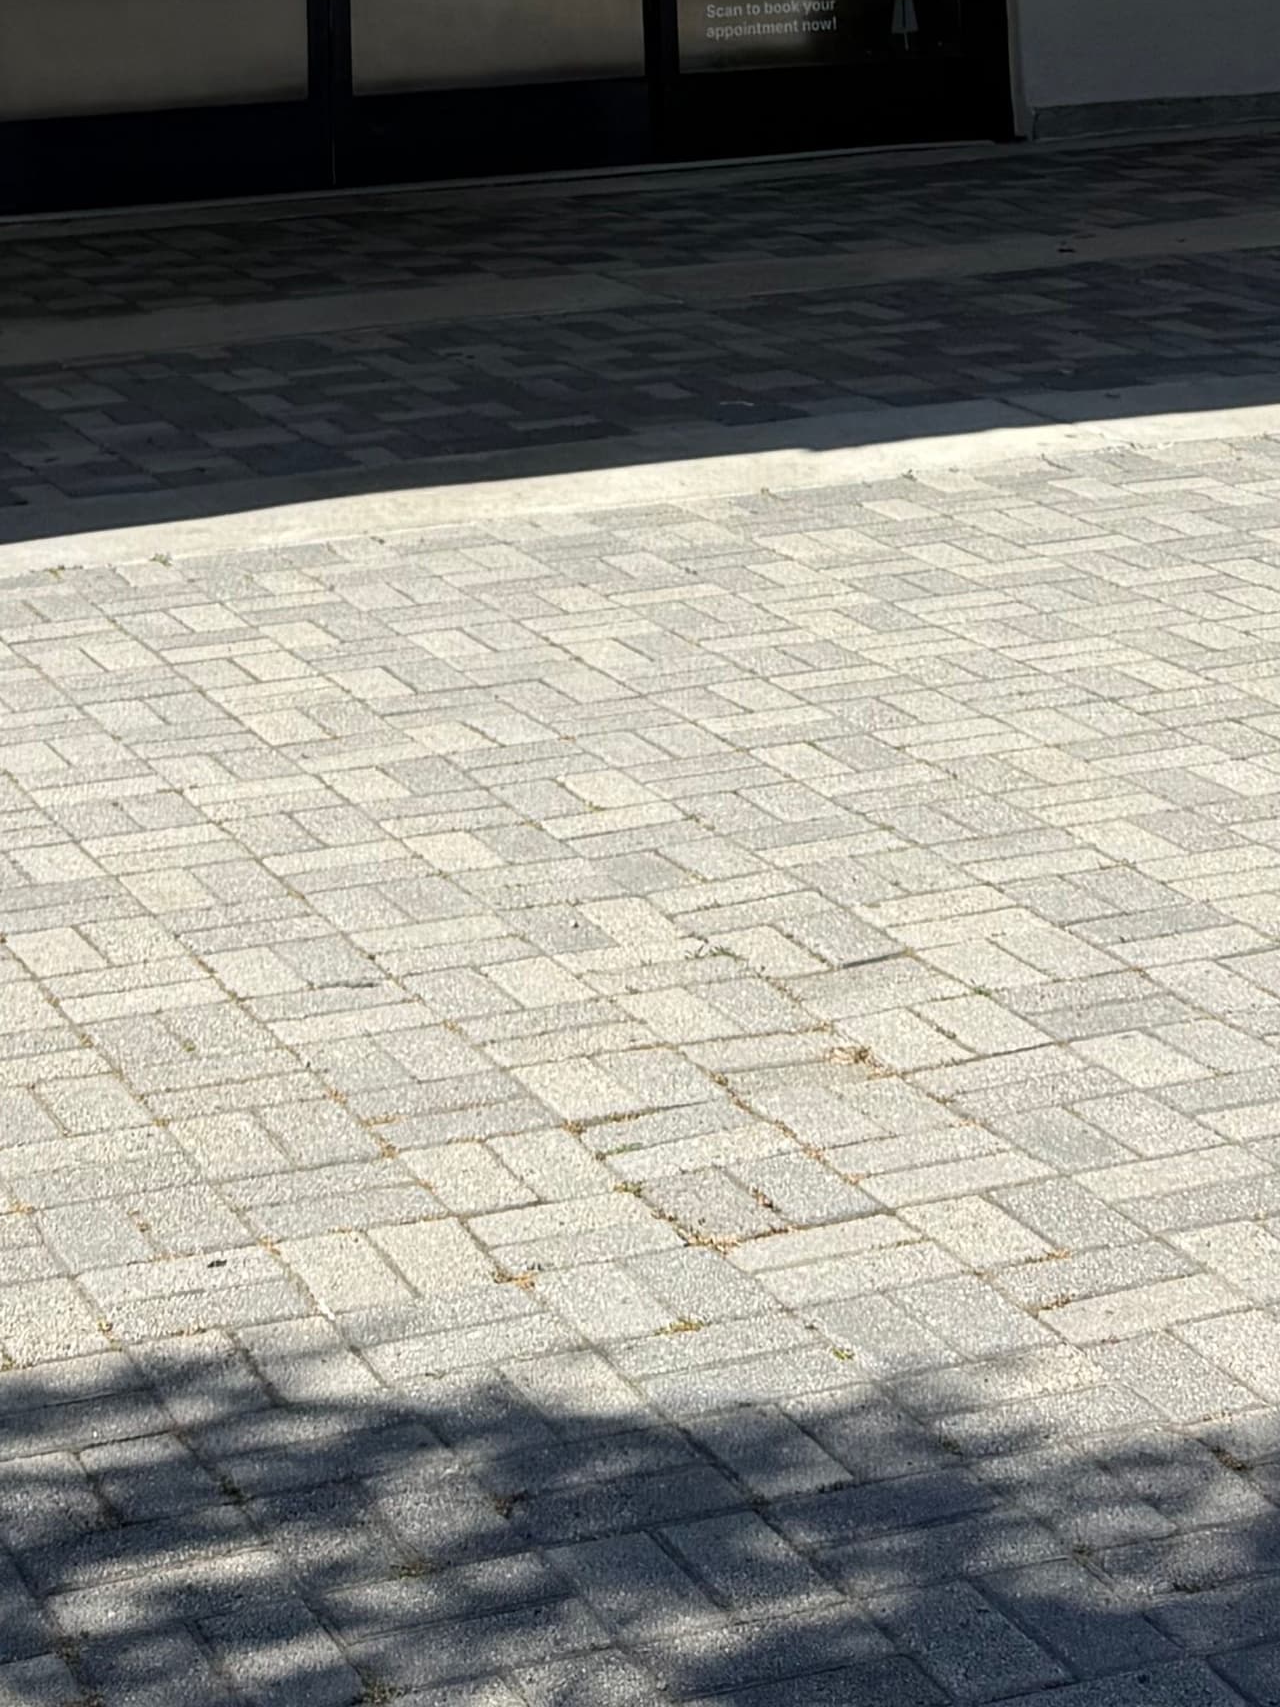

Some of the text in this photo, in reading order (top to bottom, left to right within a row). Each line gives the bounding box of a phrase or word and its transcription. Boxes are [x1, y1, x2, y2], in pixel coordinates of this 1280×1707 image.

[706, 3, 743, 19] Scan
[746, 2, 761, 16] to
[763, 0, 800, 15] book
[706, 14, 837, 41] appointment now!
